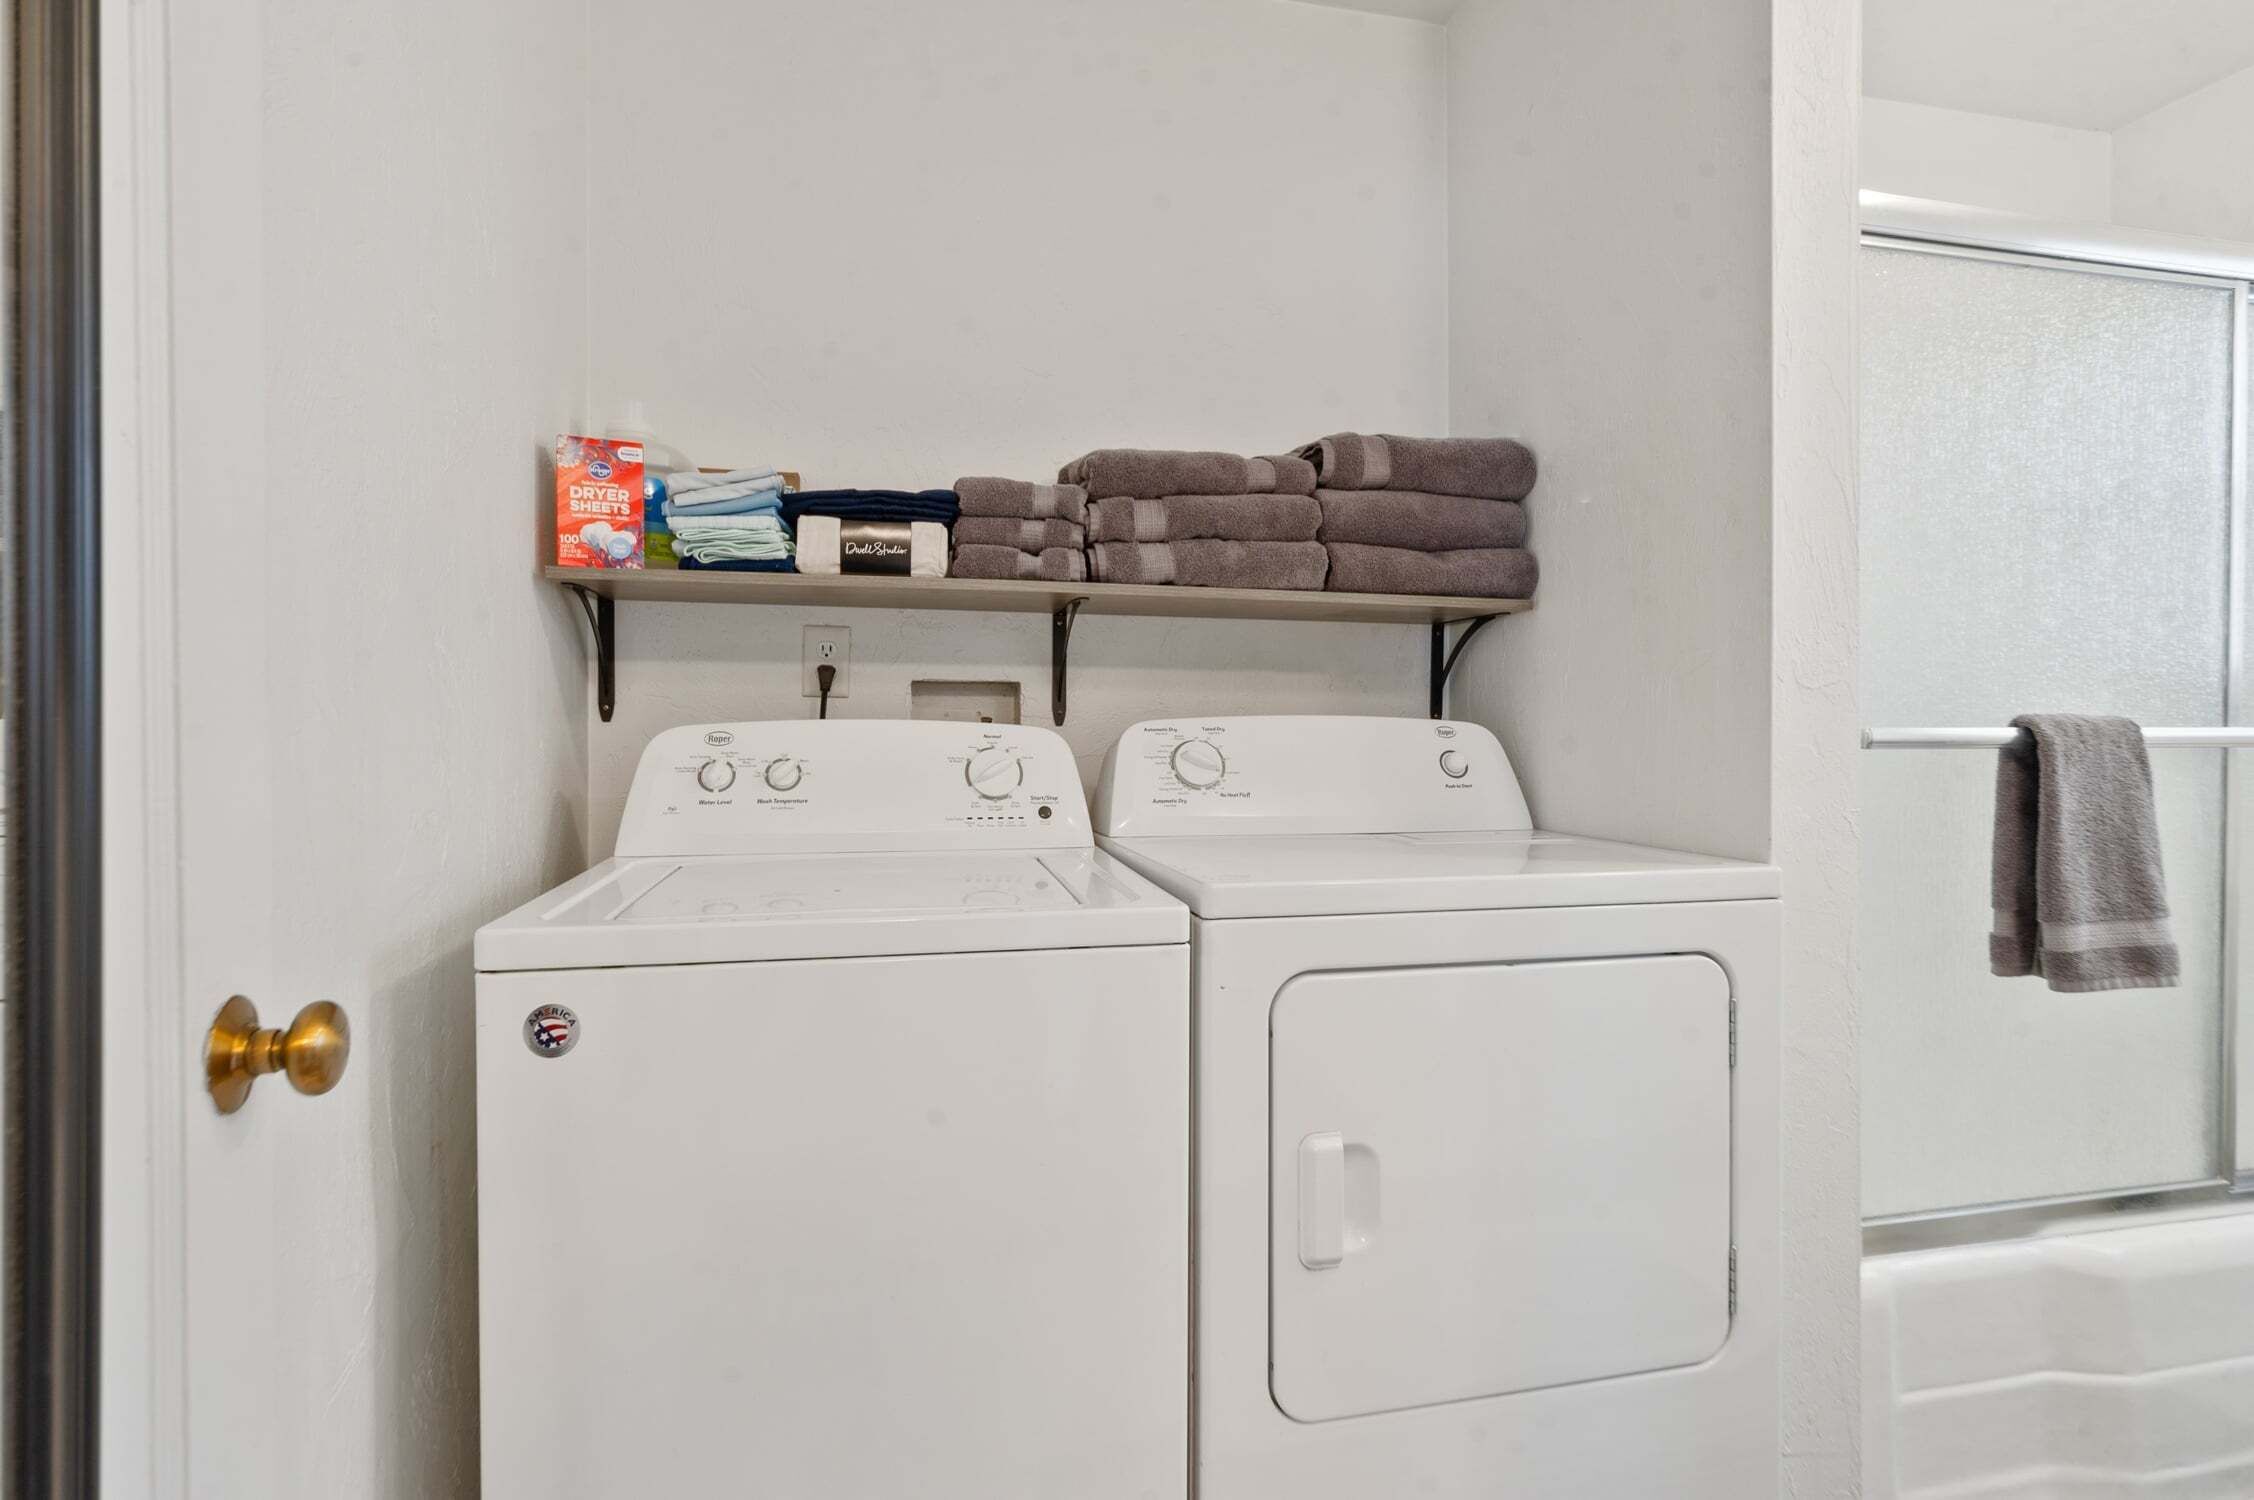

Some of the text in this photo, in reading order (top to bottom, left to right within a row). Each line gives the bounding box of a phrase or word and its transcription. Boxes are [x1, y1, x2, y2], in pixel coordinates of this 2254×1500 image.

[569, 486, 630, 503] DRYER
[569, 499, 631, 515] SHEETS
[560, 534, 580, 544] 100
[707, 735, 731, 744] Roper
[528, 1007, 577, 1028] AMERICA
